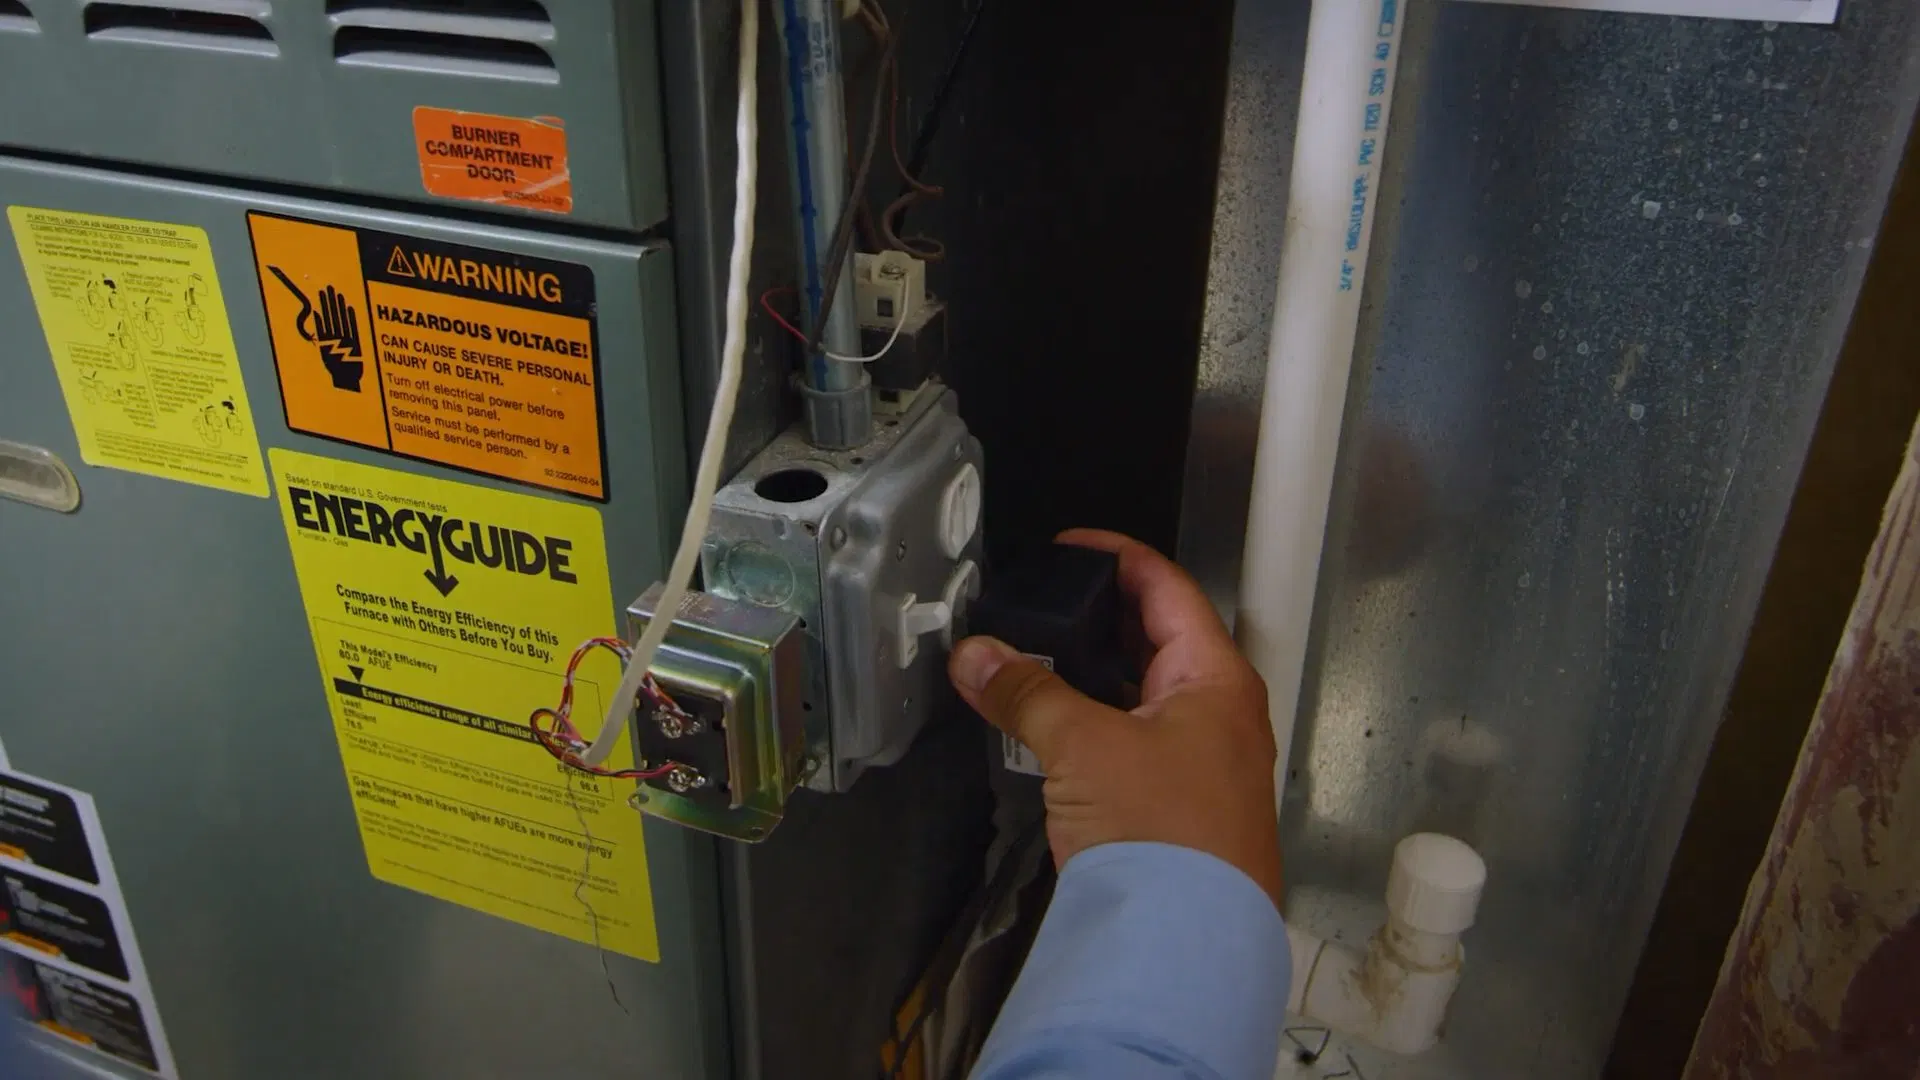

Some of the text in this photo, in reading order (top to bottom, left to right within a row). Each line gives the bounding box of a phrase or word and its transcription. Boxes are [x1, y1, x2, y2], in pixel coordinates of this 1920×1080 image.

[452, 125, 521, 148] BURNER
[1358, 138, 1376, 166] PVC
[1369, 68, 1387, 97] SCH
[425, 140, 554, 170] COMPARTMENT
[467, 164, 516, 184] DOOR
[413, 252, 562, 303] WARNING
[377, 304, 589, 360] HAZARDOUS VOLTAGE!
[381, 334, 592, 386] CAN CAUSE SEVERE PERSONAL
[384, 350, 505, 387] INJURY OR DEATH.
[386, 372, 565, 421] Turn off electrical power before
[388, 389, 501, 422] removing this panel.
[391, 405, 571, 455] Service must be performed by a
[394, 421, 528, 460] qualified service person.
[285, 473, 310, 487] Based
[311, 479, 322, 489] on
[323, 480, 357, 496] standard
[358, 487, 374, 499] U.S.
[377, 491, 427, 508] Government
[289, 486, 578, 590] ENERGYGUIDE
[336, 583, 560, 647] Compare the Energy Efficiency of this
[344, 601, 554, 664] Furnace with Others Before You Buy.
[338, 648, 393, 672] 80.0 AFUE
[340, 639, 438, 674] This Model's Efficiency
[362, 687, 532, 740] Energy efficiency range of all similar
[352, 775, 613, 860] Gas furnaces that have higher AFUEs are more energy
[355, 789, 400, 809] efficient.
